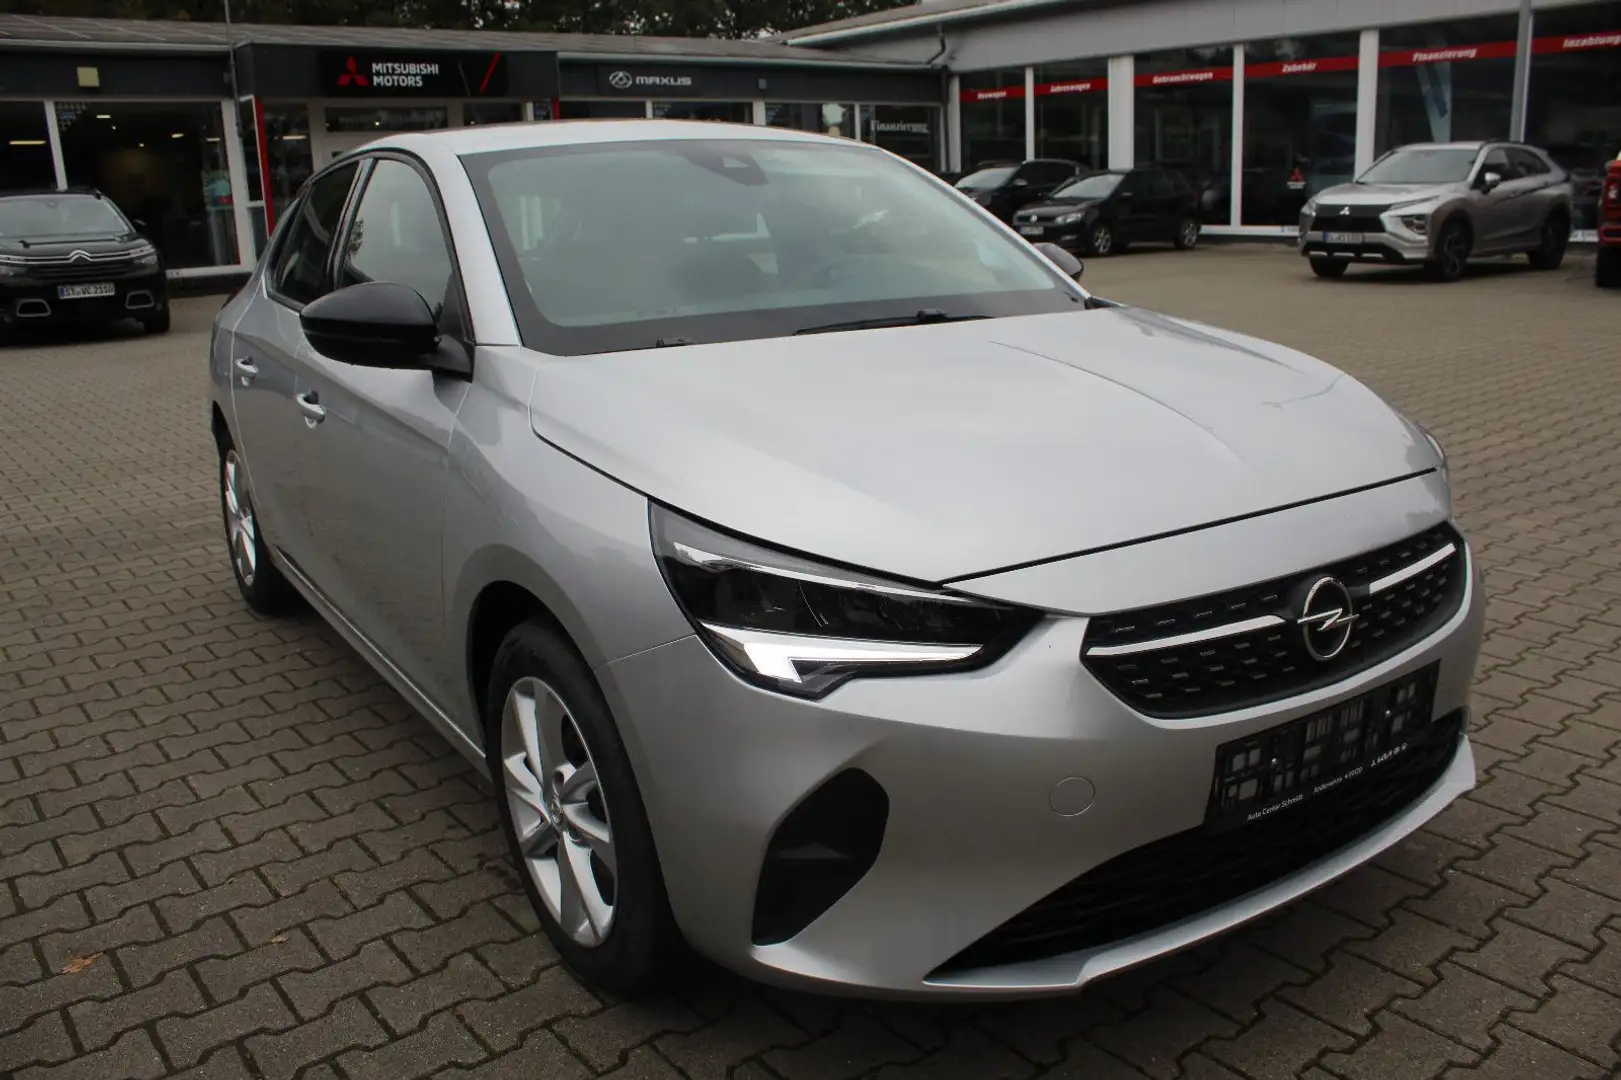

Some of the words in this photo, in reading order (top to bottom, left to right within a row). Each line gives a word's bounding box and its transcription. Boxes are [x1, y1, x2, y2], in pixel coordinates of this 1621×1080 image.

[1412, 48, 1477, 62] Finanzierung
[372, 63, 439, 75] MITSUBISHI
[1281, 62, 1317, 74] Zubehör
[373, 75, 423, 87] MOTORS
[636, 76, 692, 86] MAXUS
[1152, 72, 1214, 84] Gebrauchtwagen
[1247, 812, 1262, 821] Auto
